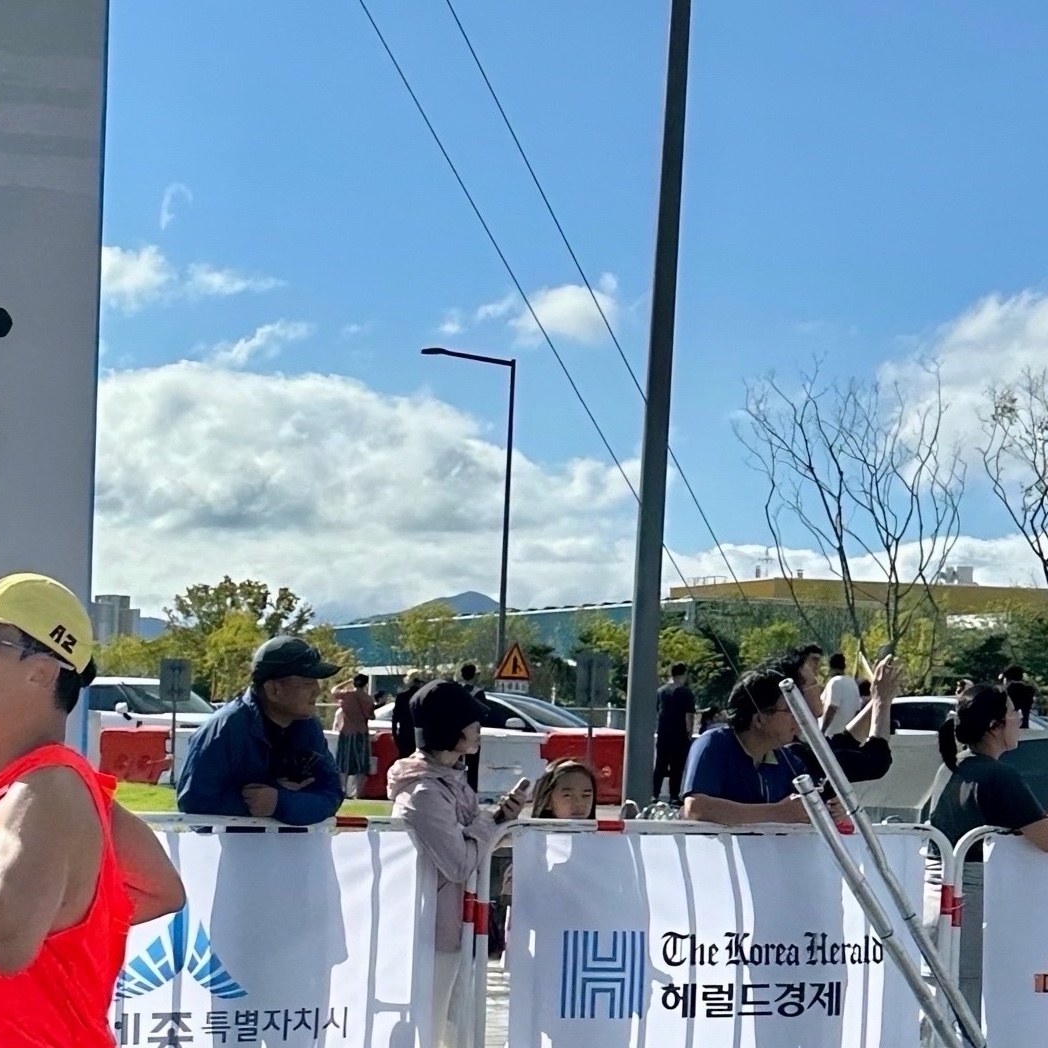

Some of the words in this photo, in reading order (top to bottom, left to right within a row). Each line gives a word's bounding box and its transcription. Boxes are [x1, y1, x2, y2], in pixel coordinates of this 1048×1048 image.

[660, 931, 718, 967] The
[724, 932, 799, 967] Korea
[803, 931, 884, 965] Herald
[660, 982, 841, 1018] 헤럴드경제
[202, 1006, 348, 1043] 특별자치시
